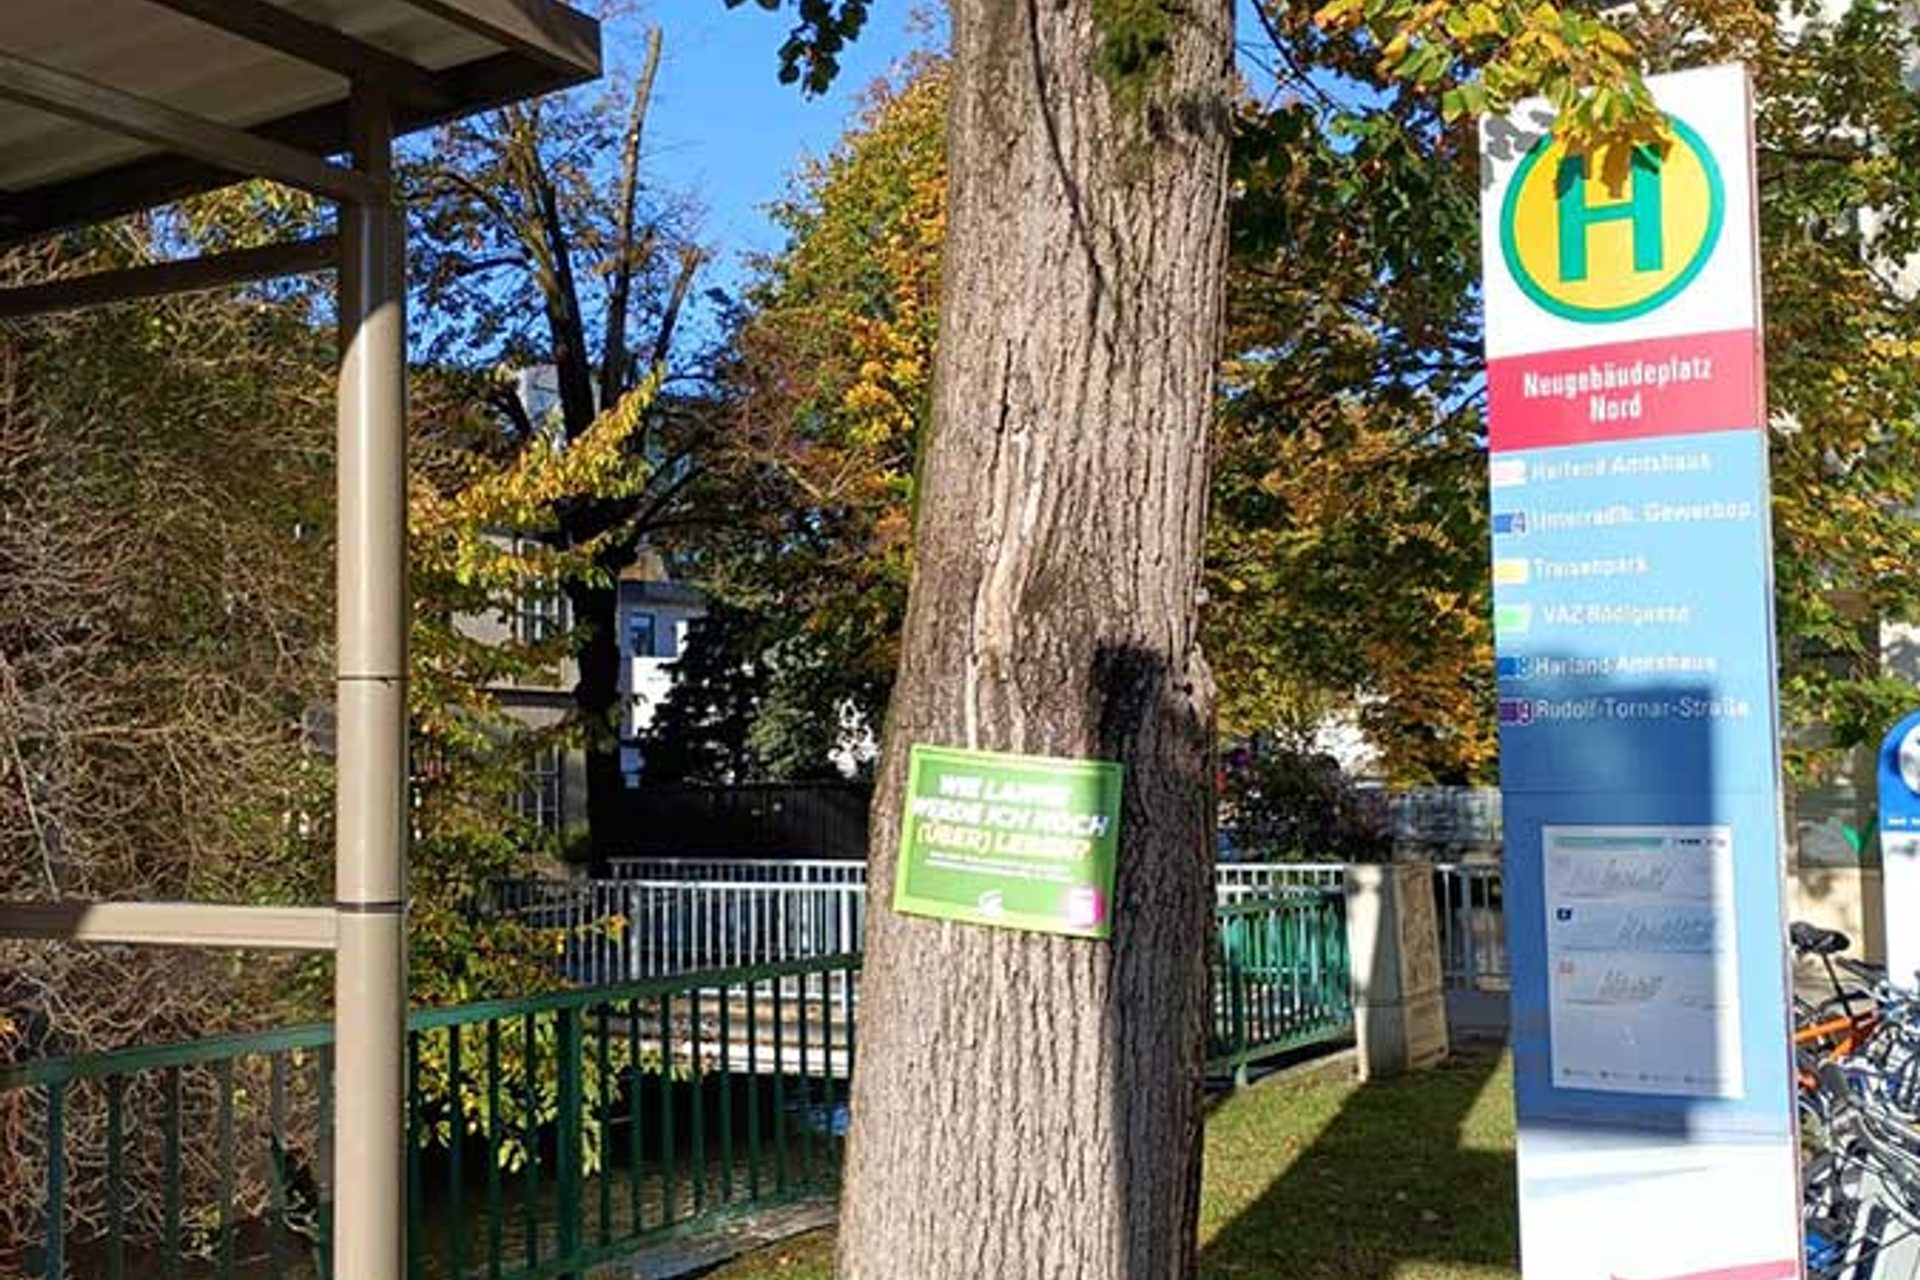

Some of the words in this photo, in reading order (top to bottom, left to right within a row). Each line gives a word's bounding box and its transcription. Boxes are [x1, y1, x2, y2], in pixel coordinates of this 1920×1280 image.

[1556, 144, 1663, 283] H
[1524, 356, 1712, 399] Neugebäudeplatz
[1590, 391, 1642, 422] Nord
